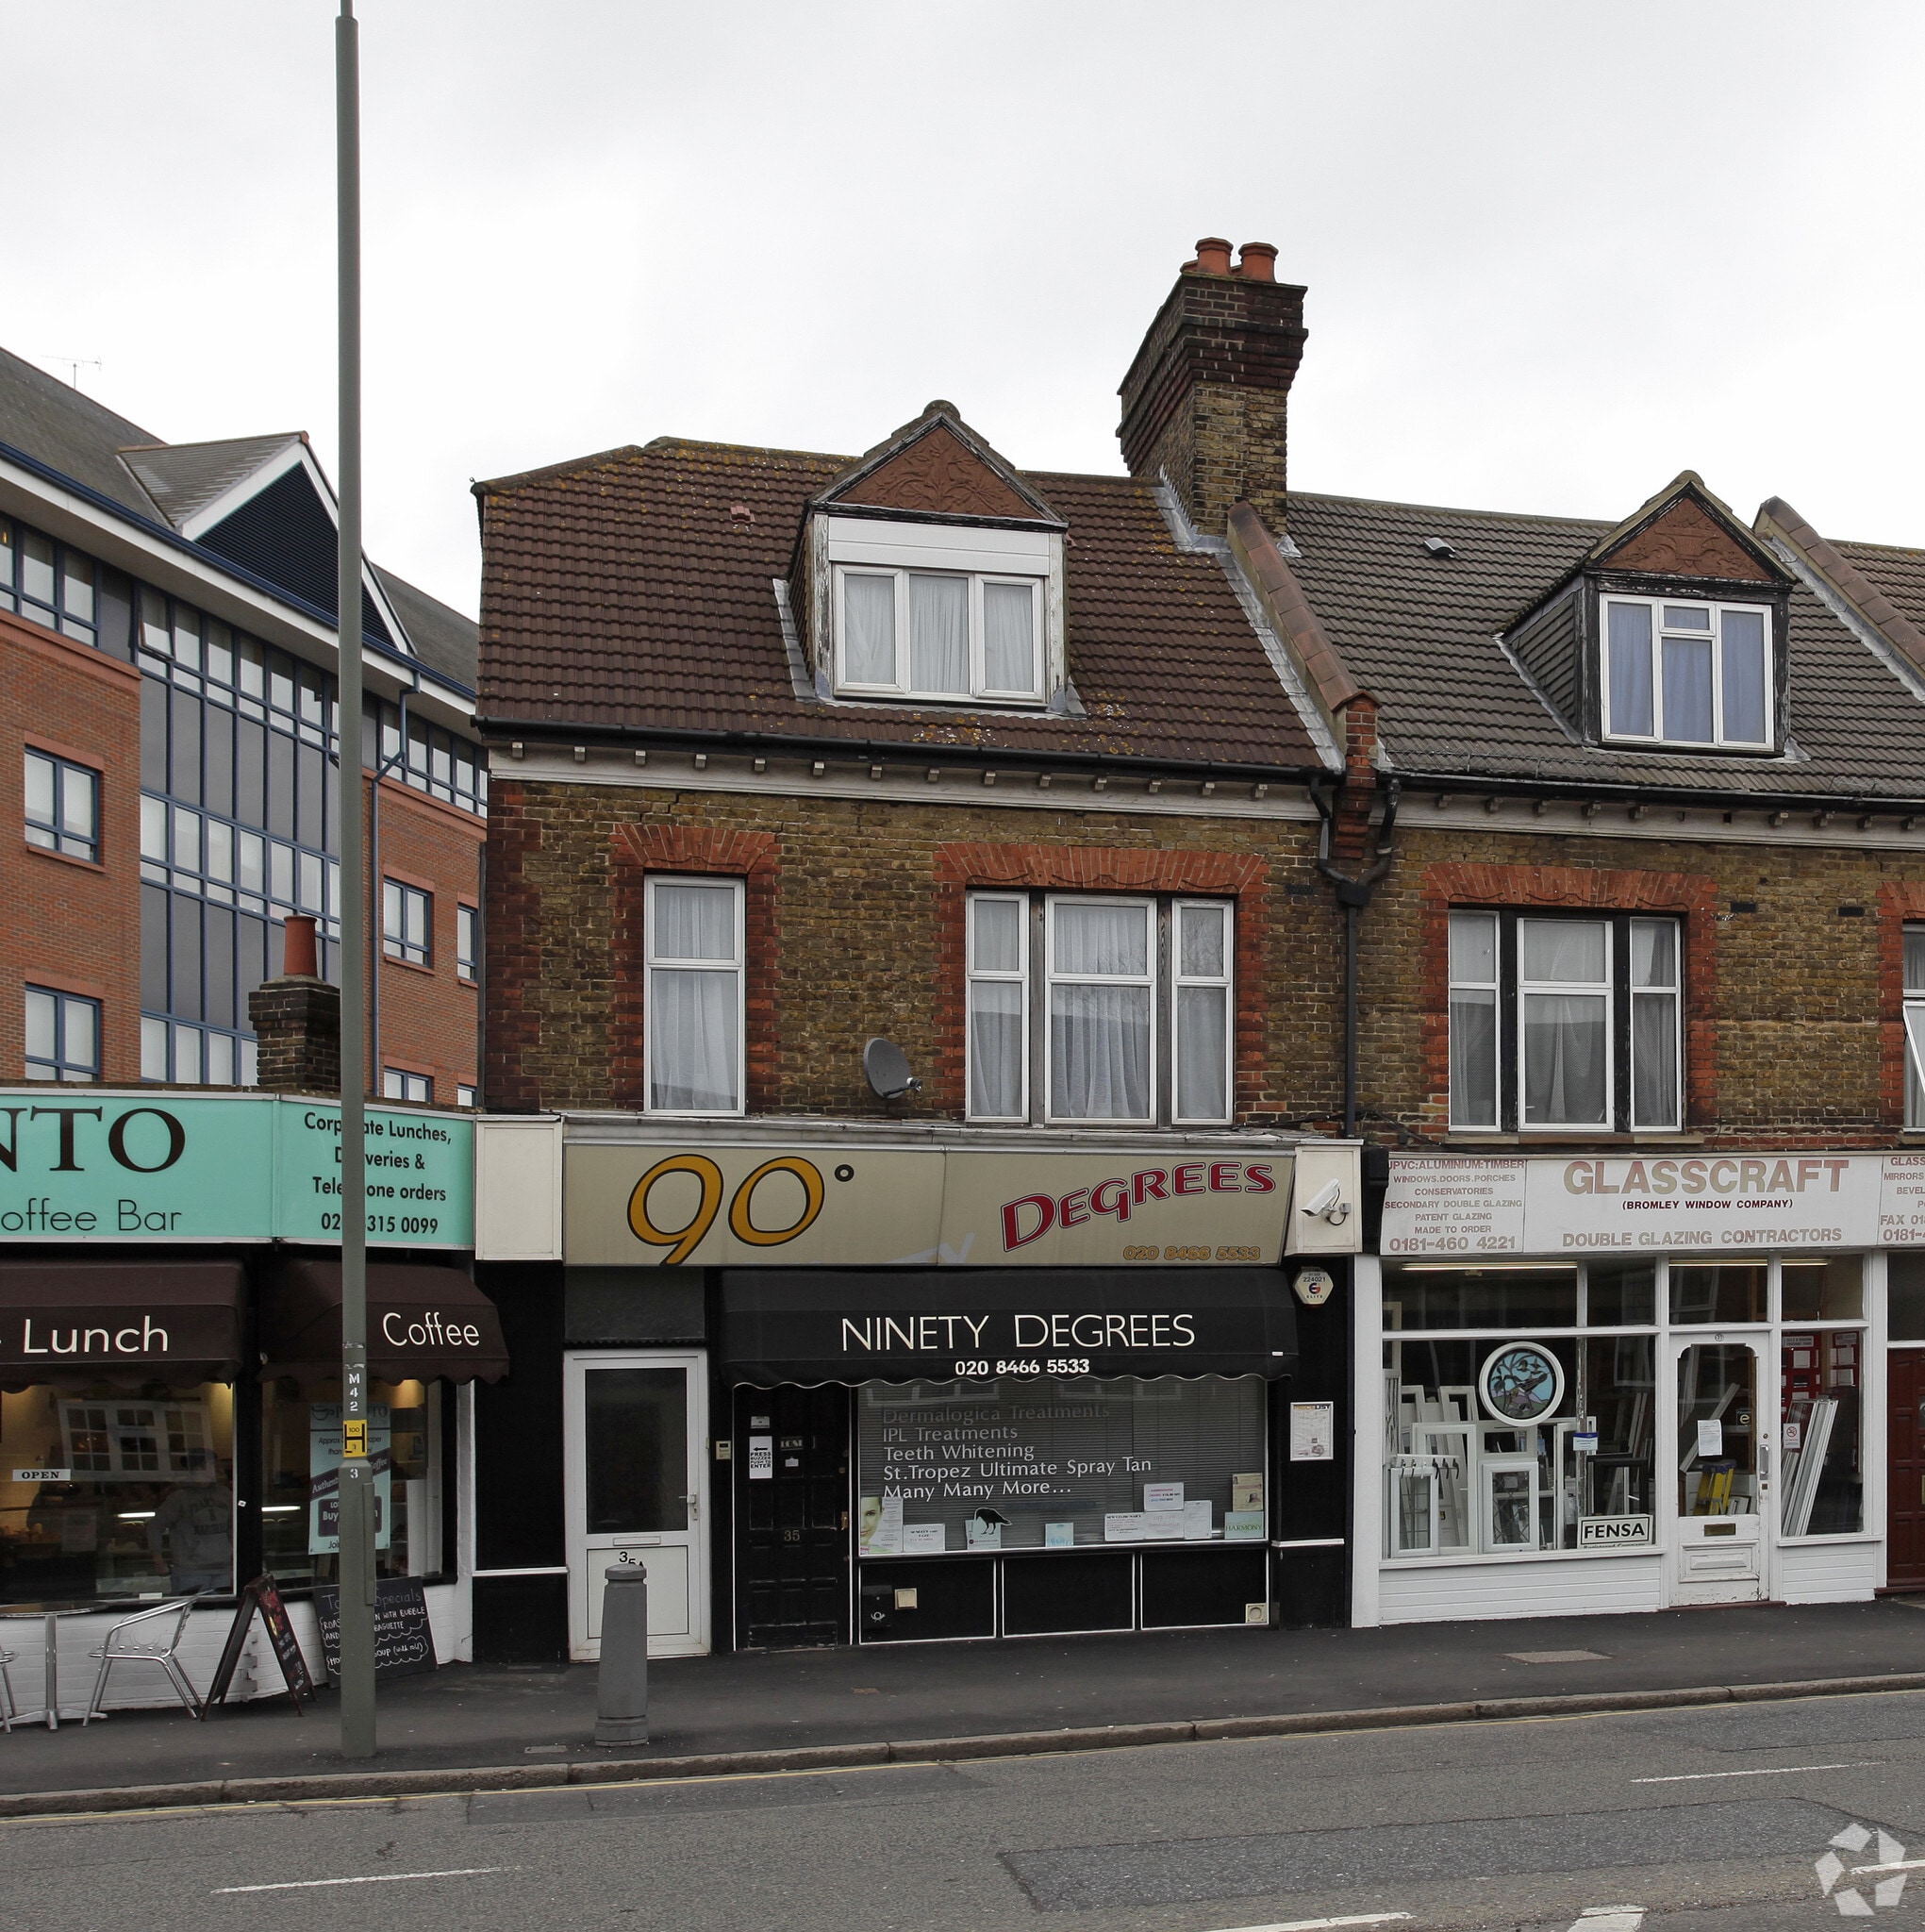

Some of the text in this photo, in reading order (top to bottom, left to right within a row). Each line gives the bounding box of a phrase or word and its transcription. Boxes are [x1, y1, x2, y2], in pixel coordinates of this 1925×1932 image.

[304, 1111, 452, 1145] Corpate Lunches,
[415, 1153, 425, 1170] &
[1562, 1159, 1850, 1195] GLASSCRAFT
[1884, 1172, 1924, 1181] MIRRORS
[312, 1176, 447, 1202] Teleone orders
[1414, 1187, 1494, 1196] CONSERVATORIES
[1001, 1161, 1276, 1252] DEGREES
[1384, 1199, 1523, 1209] SECONDARY DOUBLE GLAZING
[1622, 1198, 1794, 1210] (BROMLEY WINDOW COMPANY)
[118, 1199, 182, 1231] Bar
[1414, 1212, 1493, 1221] PATENT GLAZING
[1880, 1214, 1905, 1225] FAX
[366, 1214, 395, 1233] 315
[401, 1216, 439, 1234] 0099
[1414, 1224, 1492, 1234] MADE TO ORDER
[1388, 1236, 1517, 1252] 0181-460 4221
[1562, 1227, 1842, 1247] DOUBLE GLAZING CONTRACTORS
[1123, 1245, 1260, 1260] 020 8466 5533
[24, 1315, 168, 1354] Lunch
[382, 1311, 480, 1346] Coffee
[841, 1313, 1196, 1352] NINETY DEGREES
[954, 1358, 1090, 1375] 020 8466 5533
[883, 1405, 1111, 1426] Dermalogica Treatments
[883, 1426, 1018, 1442] IPL Treatments
[884, 1443, 1035, 1461] Teeth Whitening
[21, 1471, 60, 1479] OPEN
[883, 1457, 1153, 1482] St.Tropez Ultimate Spray Tan
[883, 1485, 935, 1503] Many
[943, 1482, 993, 1500] Many
[784, 1529, 801, 1541] 35
[1584, 1523, 1645, 1540] FENSA
